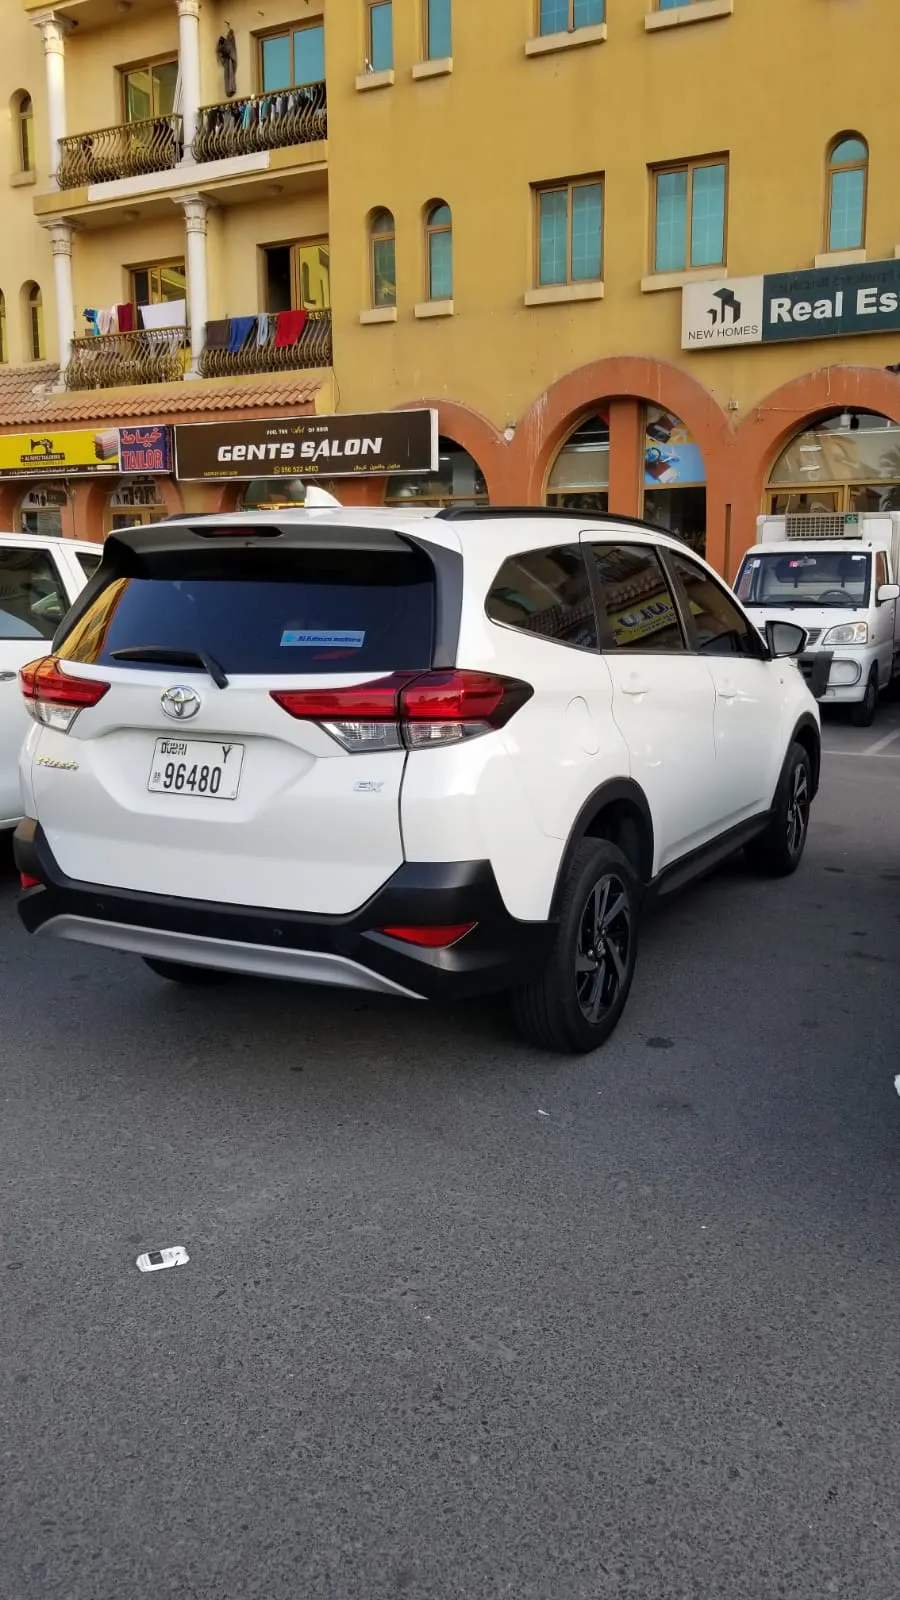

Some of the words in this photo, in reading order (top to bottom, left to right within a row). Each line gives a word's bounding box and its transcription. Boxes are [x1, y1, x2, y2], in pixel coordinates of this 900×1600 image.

[770, 291, 844, 324] Real
[856, 287, 900, 315] Es
[688, 329, 714, 340] NEW
[717, 325, 759, 337] HOMES
[121, 427, 162, 448] خياط
[122, 449, 163, 470] TAILOR
[300, 437, 383, 462] SALON
[222, 745, 233, 764] Y
[163, 762, 222, 794] 96480
[353, 780, 385, 793] EX
